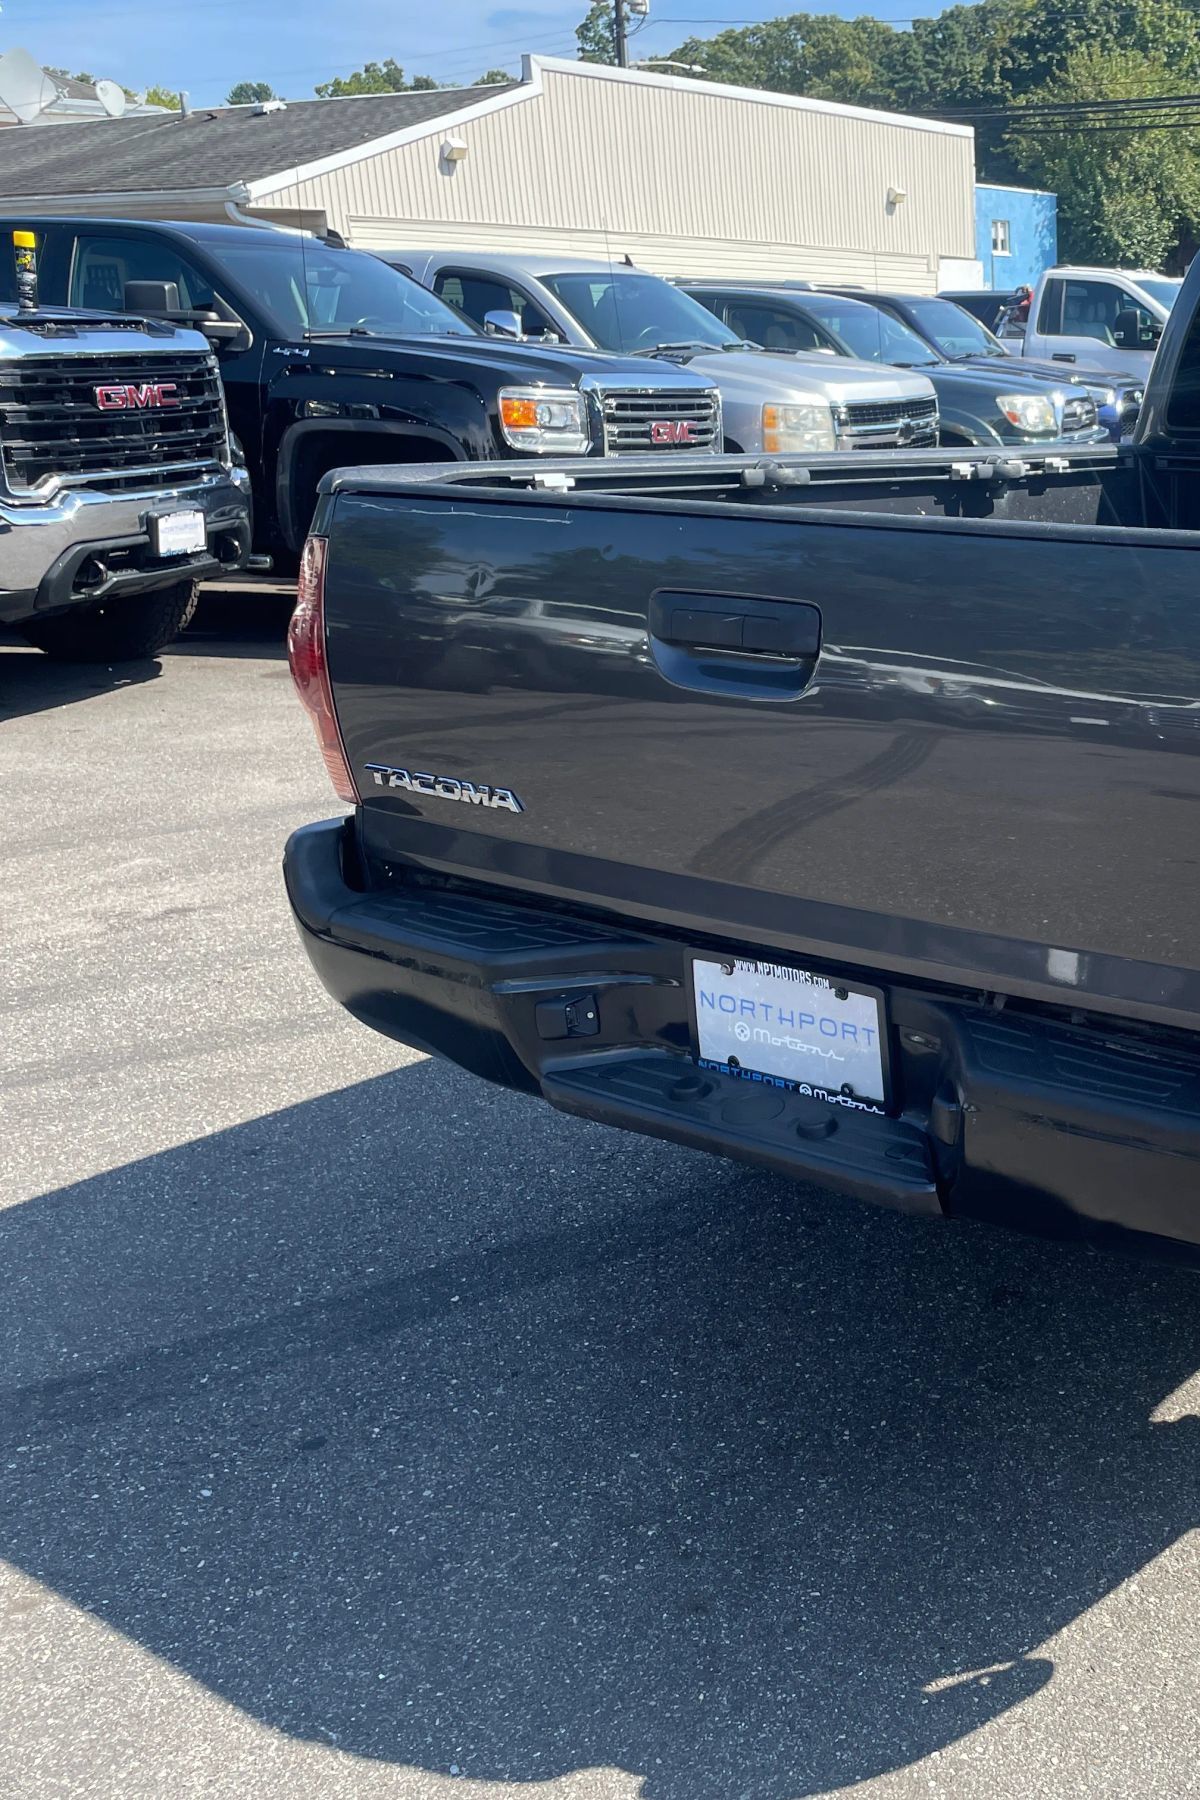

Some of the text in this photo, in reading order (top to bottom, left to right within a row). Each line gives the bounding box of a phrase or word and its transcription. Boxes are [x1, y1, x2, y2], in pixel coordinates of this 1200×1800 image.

[95, 383, 178, 410] GMC
[651, 420, 698, 443] GMC
[364, 763, 527, 814] TACOMA
[733, 959, 830, 990] WWW.NPTMOTORS.COM
[699, 989, 876, 1047] NORTHPORT
